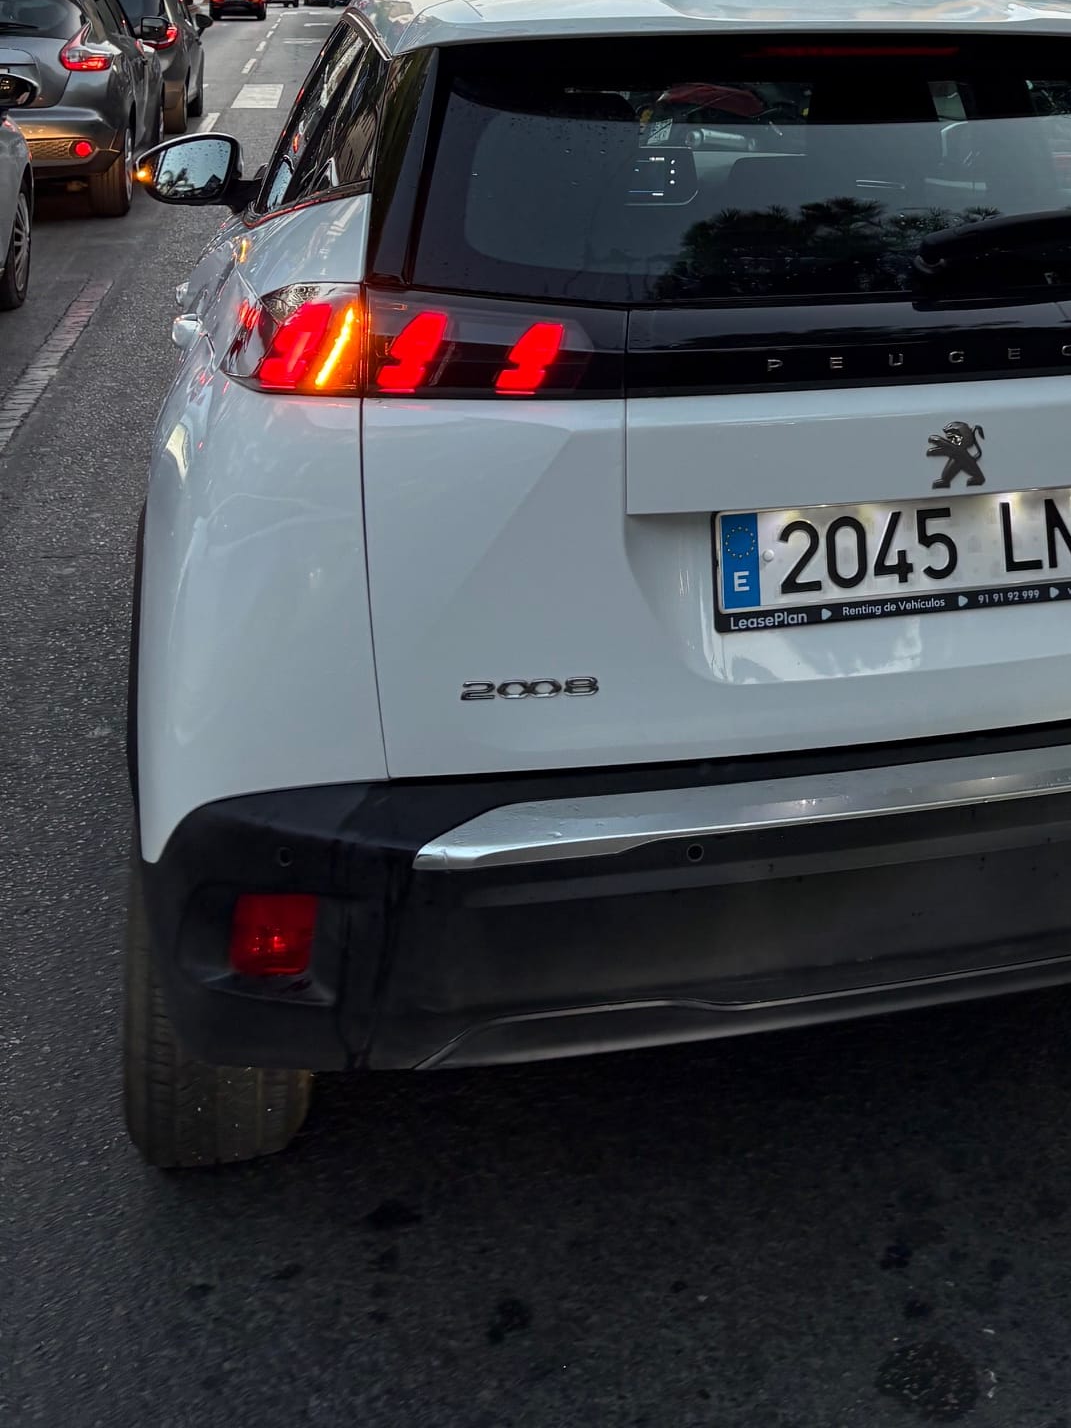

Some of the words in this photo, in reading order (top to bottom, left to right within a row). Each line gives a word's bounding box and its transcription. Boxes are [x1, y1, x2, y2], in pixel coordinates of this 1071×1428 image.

[778, 506, 958, 595] 2045
[733, 570, 750, 592] E
[730, 611, 808, 631] LeasePlan
[842, 605, 881, 617] Renting
[883, 602, 896, 613] de
[898, 597, 945, 611] Vehículos
[978, 593, 989, 604] 91
[993, 592, 1004, 603] 91
[1007, 590, 1019, 601] 92
[1022, 589, 1040, 600] 999
[460, 676, 600, 701] 2008
